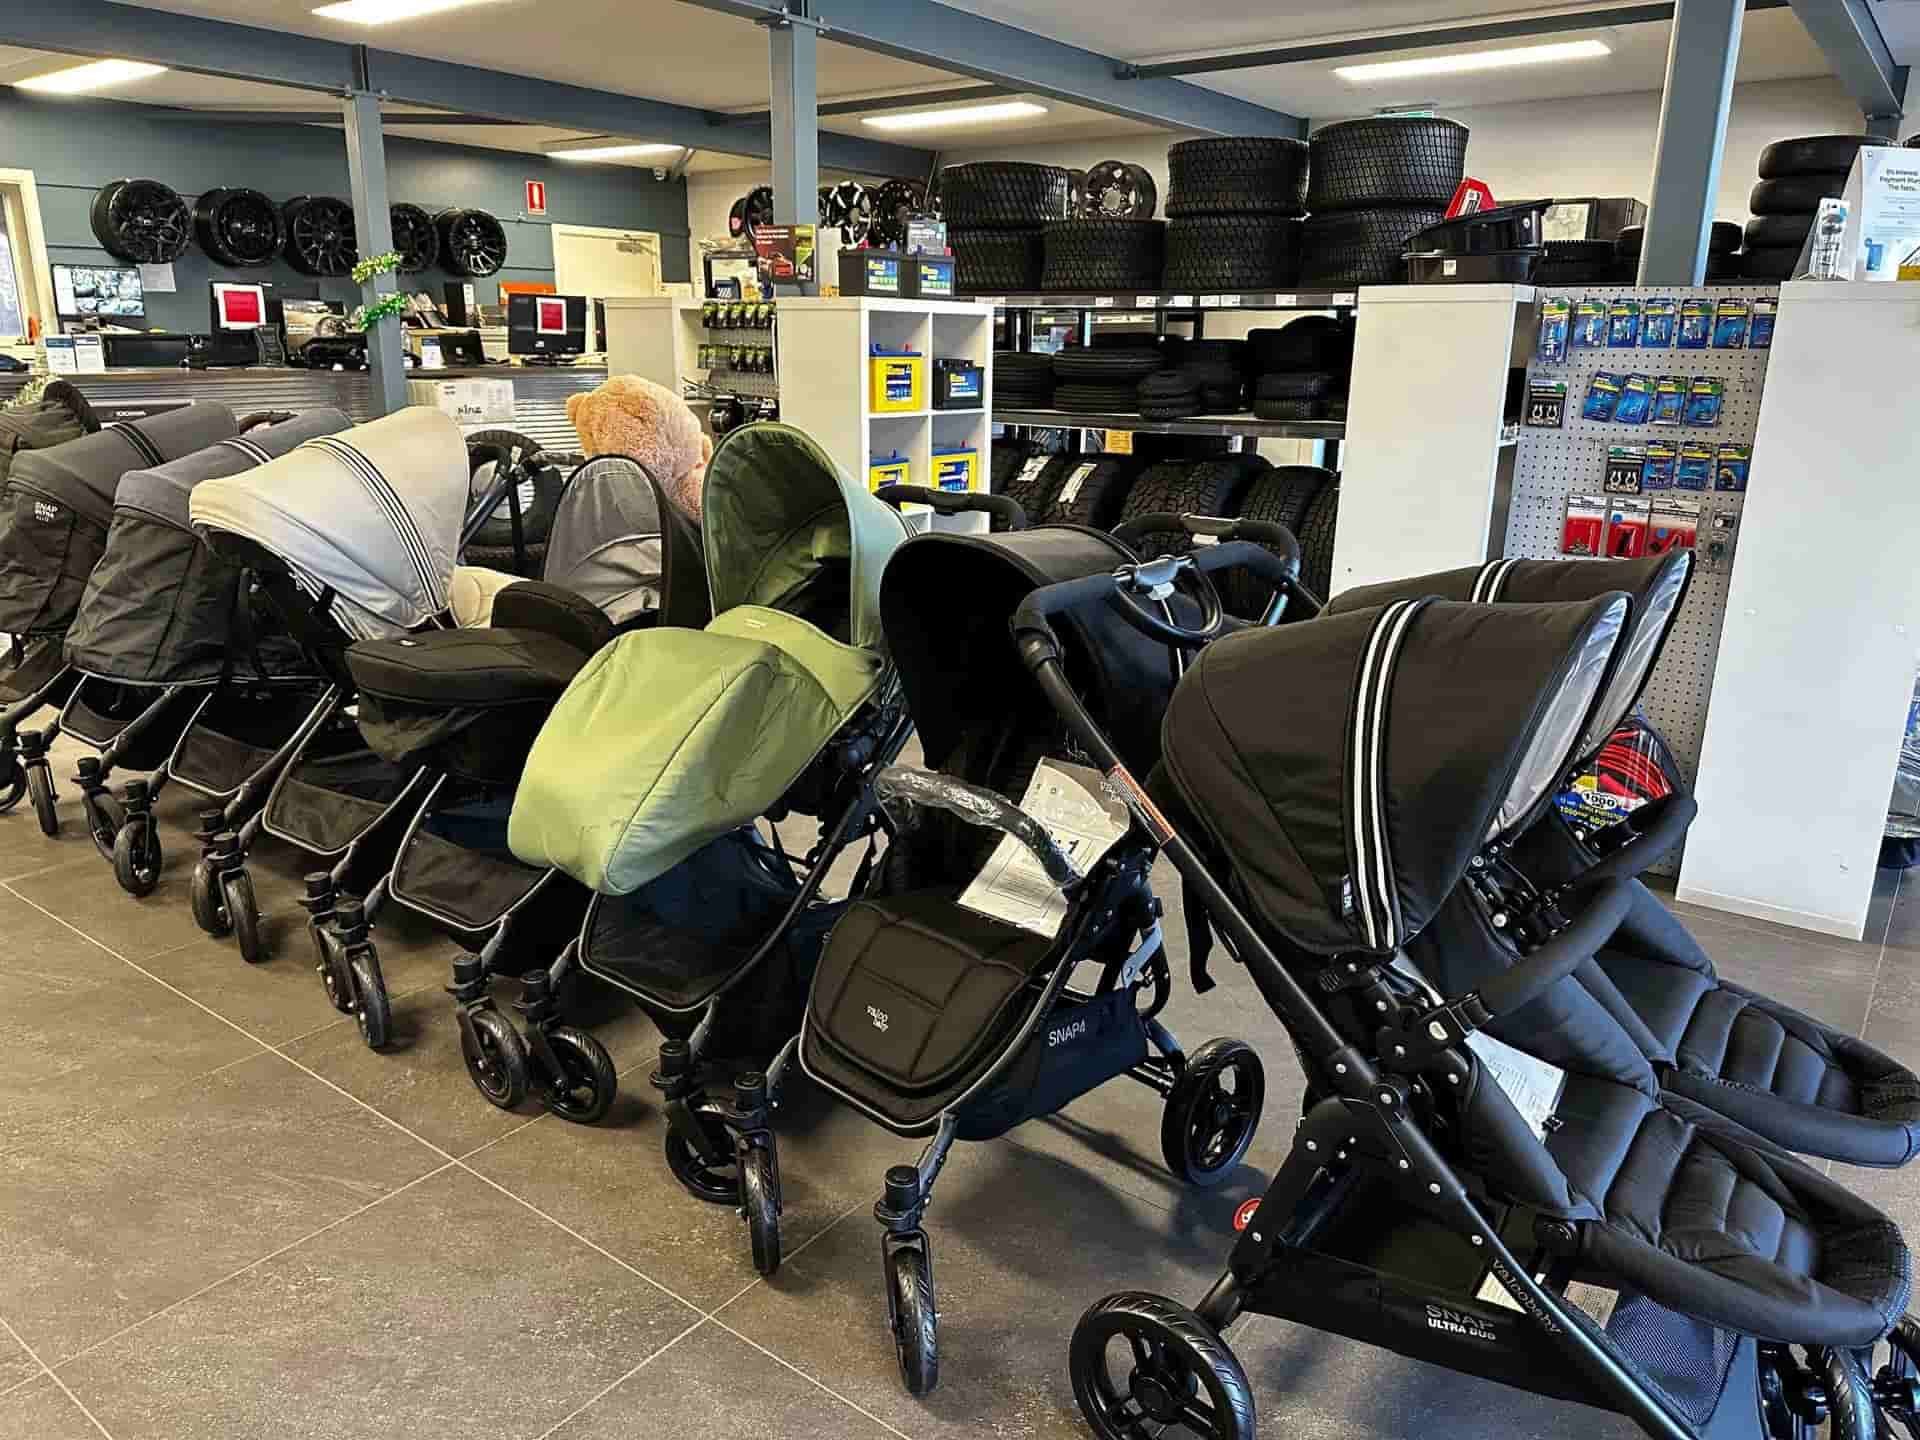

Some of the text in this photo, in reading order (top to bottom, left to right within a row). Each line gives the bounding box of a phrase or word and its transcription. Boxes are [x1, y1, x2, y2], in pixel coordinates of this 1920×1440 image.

[1583, 792, 1615, 807] 1000
[1048, 1017, 1086, 1047] SNAP4
[1425, 1304, 1495, 1330] SNAP
[1427, 1317, 1497, 1341] ULTRA DUO
